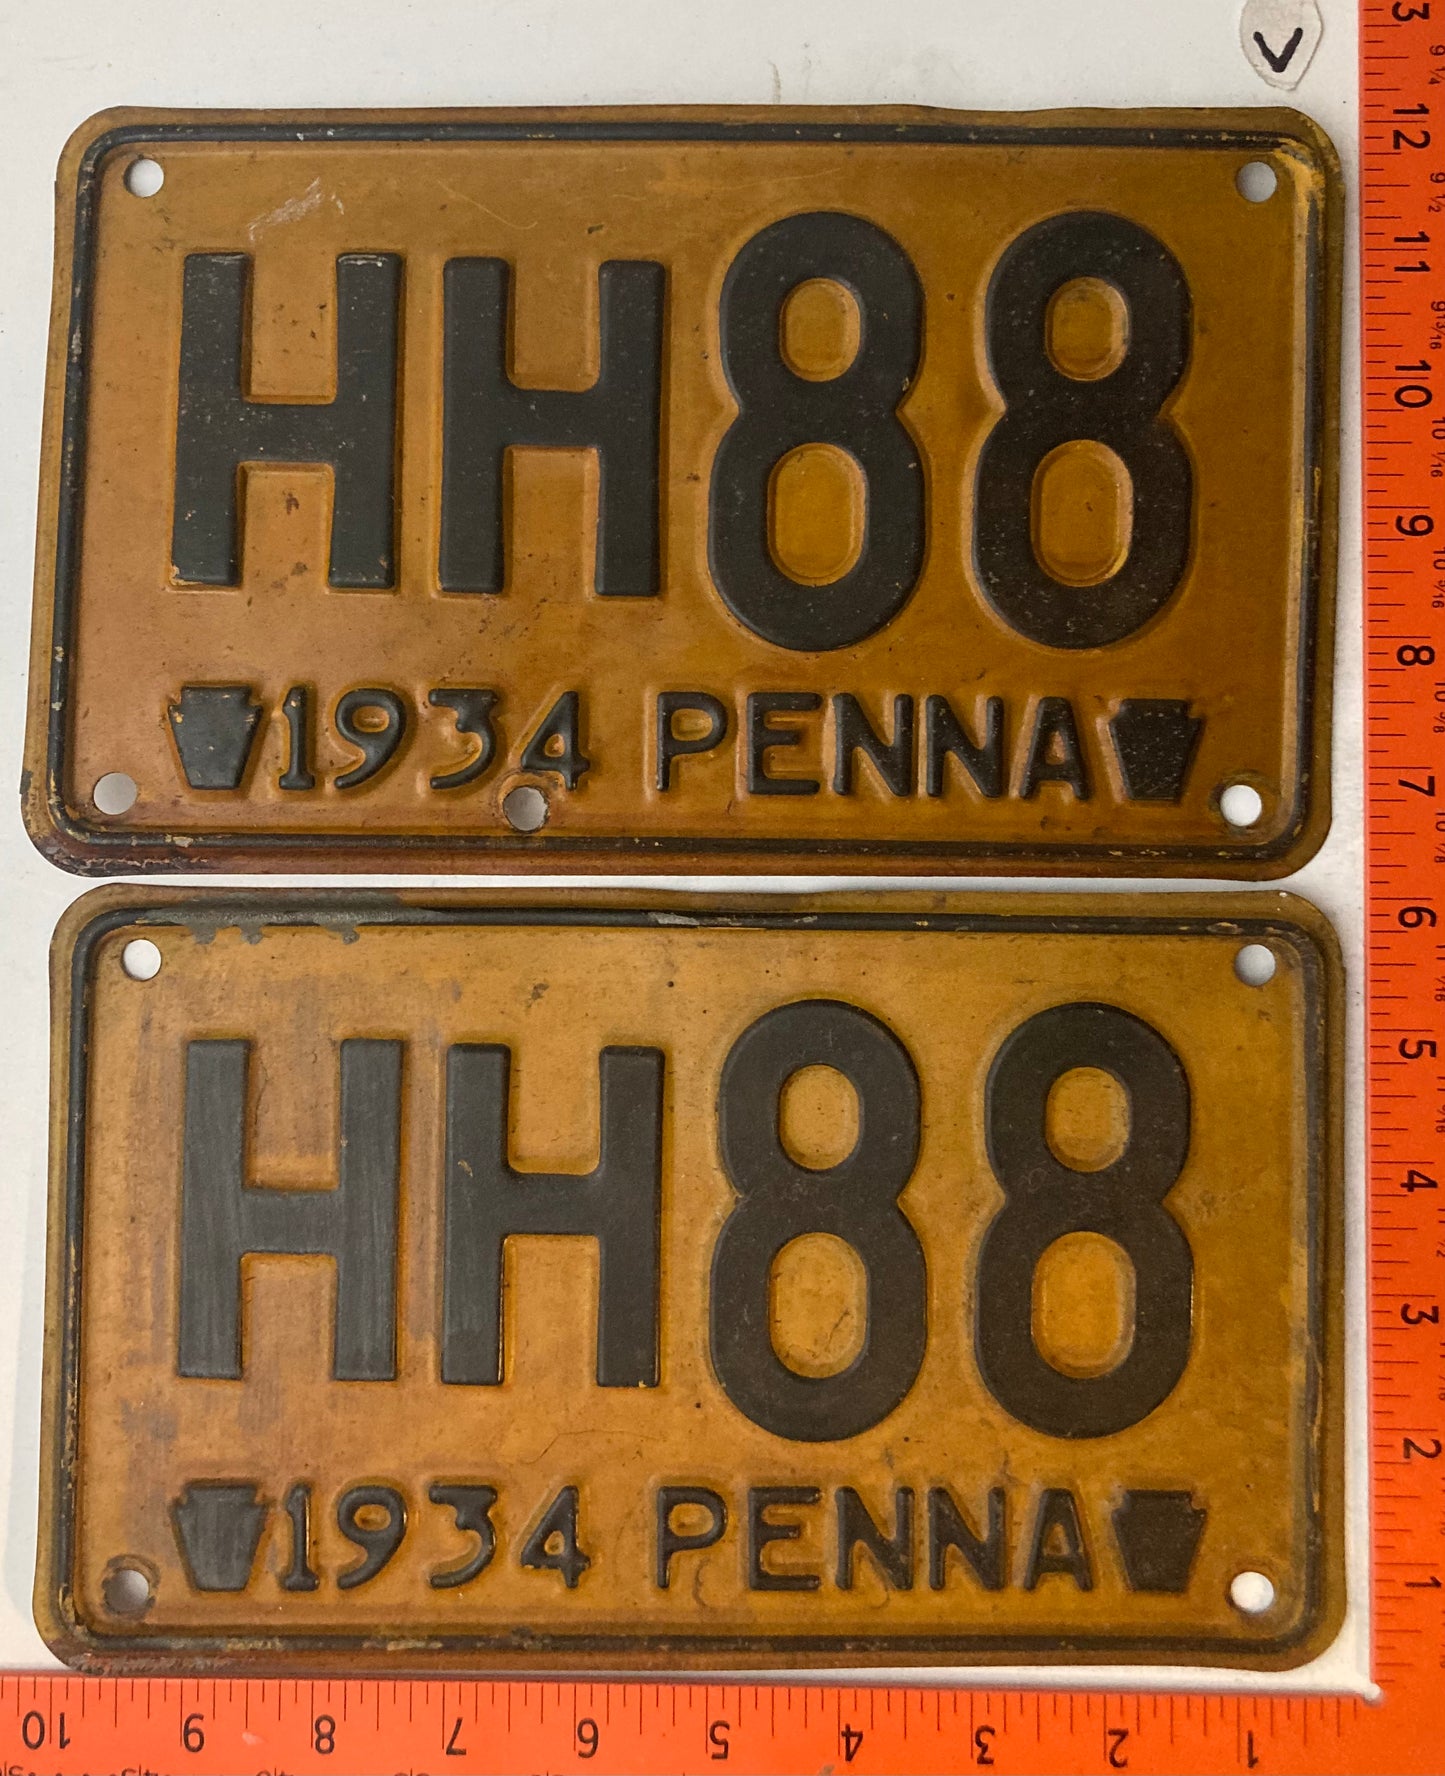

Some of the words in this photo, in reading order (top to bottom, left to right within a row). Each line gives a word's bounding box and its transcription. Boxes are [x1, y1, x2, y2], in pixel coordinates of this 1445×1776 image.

[1393, 103, 1431, 150] 12
[1394, 359, 1433, 408] 10
[172, 211, 1194, 652] HH88
[1395, 514, 1434, 537] 9
[1396, 644, 1435, 666] 8
[277, 686, 591, 790] 1934
[656, 692, 1089, 798] PENNA
[1398, 775, 1435, 797] 7
[1398, 906, 1437, 928] 6
[1398, 1038, 1437, 1059] 5
[1400, 1169, 1438, 1192] 4
[178, 999, 1196, 1442] HH88
[1400, 1303, 1439, 1325] 3
[1403, 1437, 1442, 1459] 2
[280, 1484, 591, 1590] 1934
[656, 1486, 1093, 1592] PENNA
[1405, 1576, 1442, 1588] 1
[22, 1710, 71, 1750] 10
[182, 1713, 205, 1753] 9
[314, 1715, 336, 1755] 8
[445, 1717, 468, 1756] 7
[576, 1718, 599, 1758] 6
[709, 1720, 730, 1760] 5
[841, 1723, 863, 1762] 4
[974, 1725, 996, 1765] 3
[1107, 1728, 1129, 1768] 2
[1247, 1730, 1259, 1768] 1
